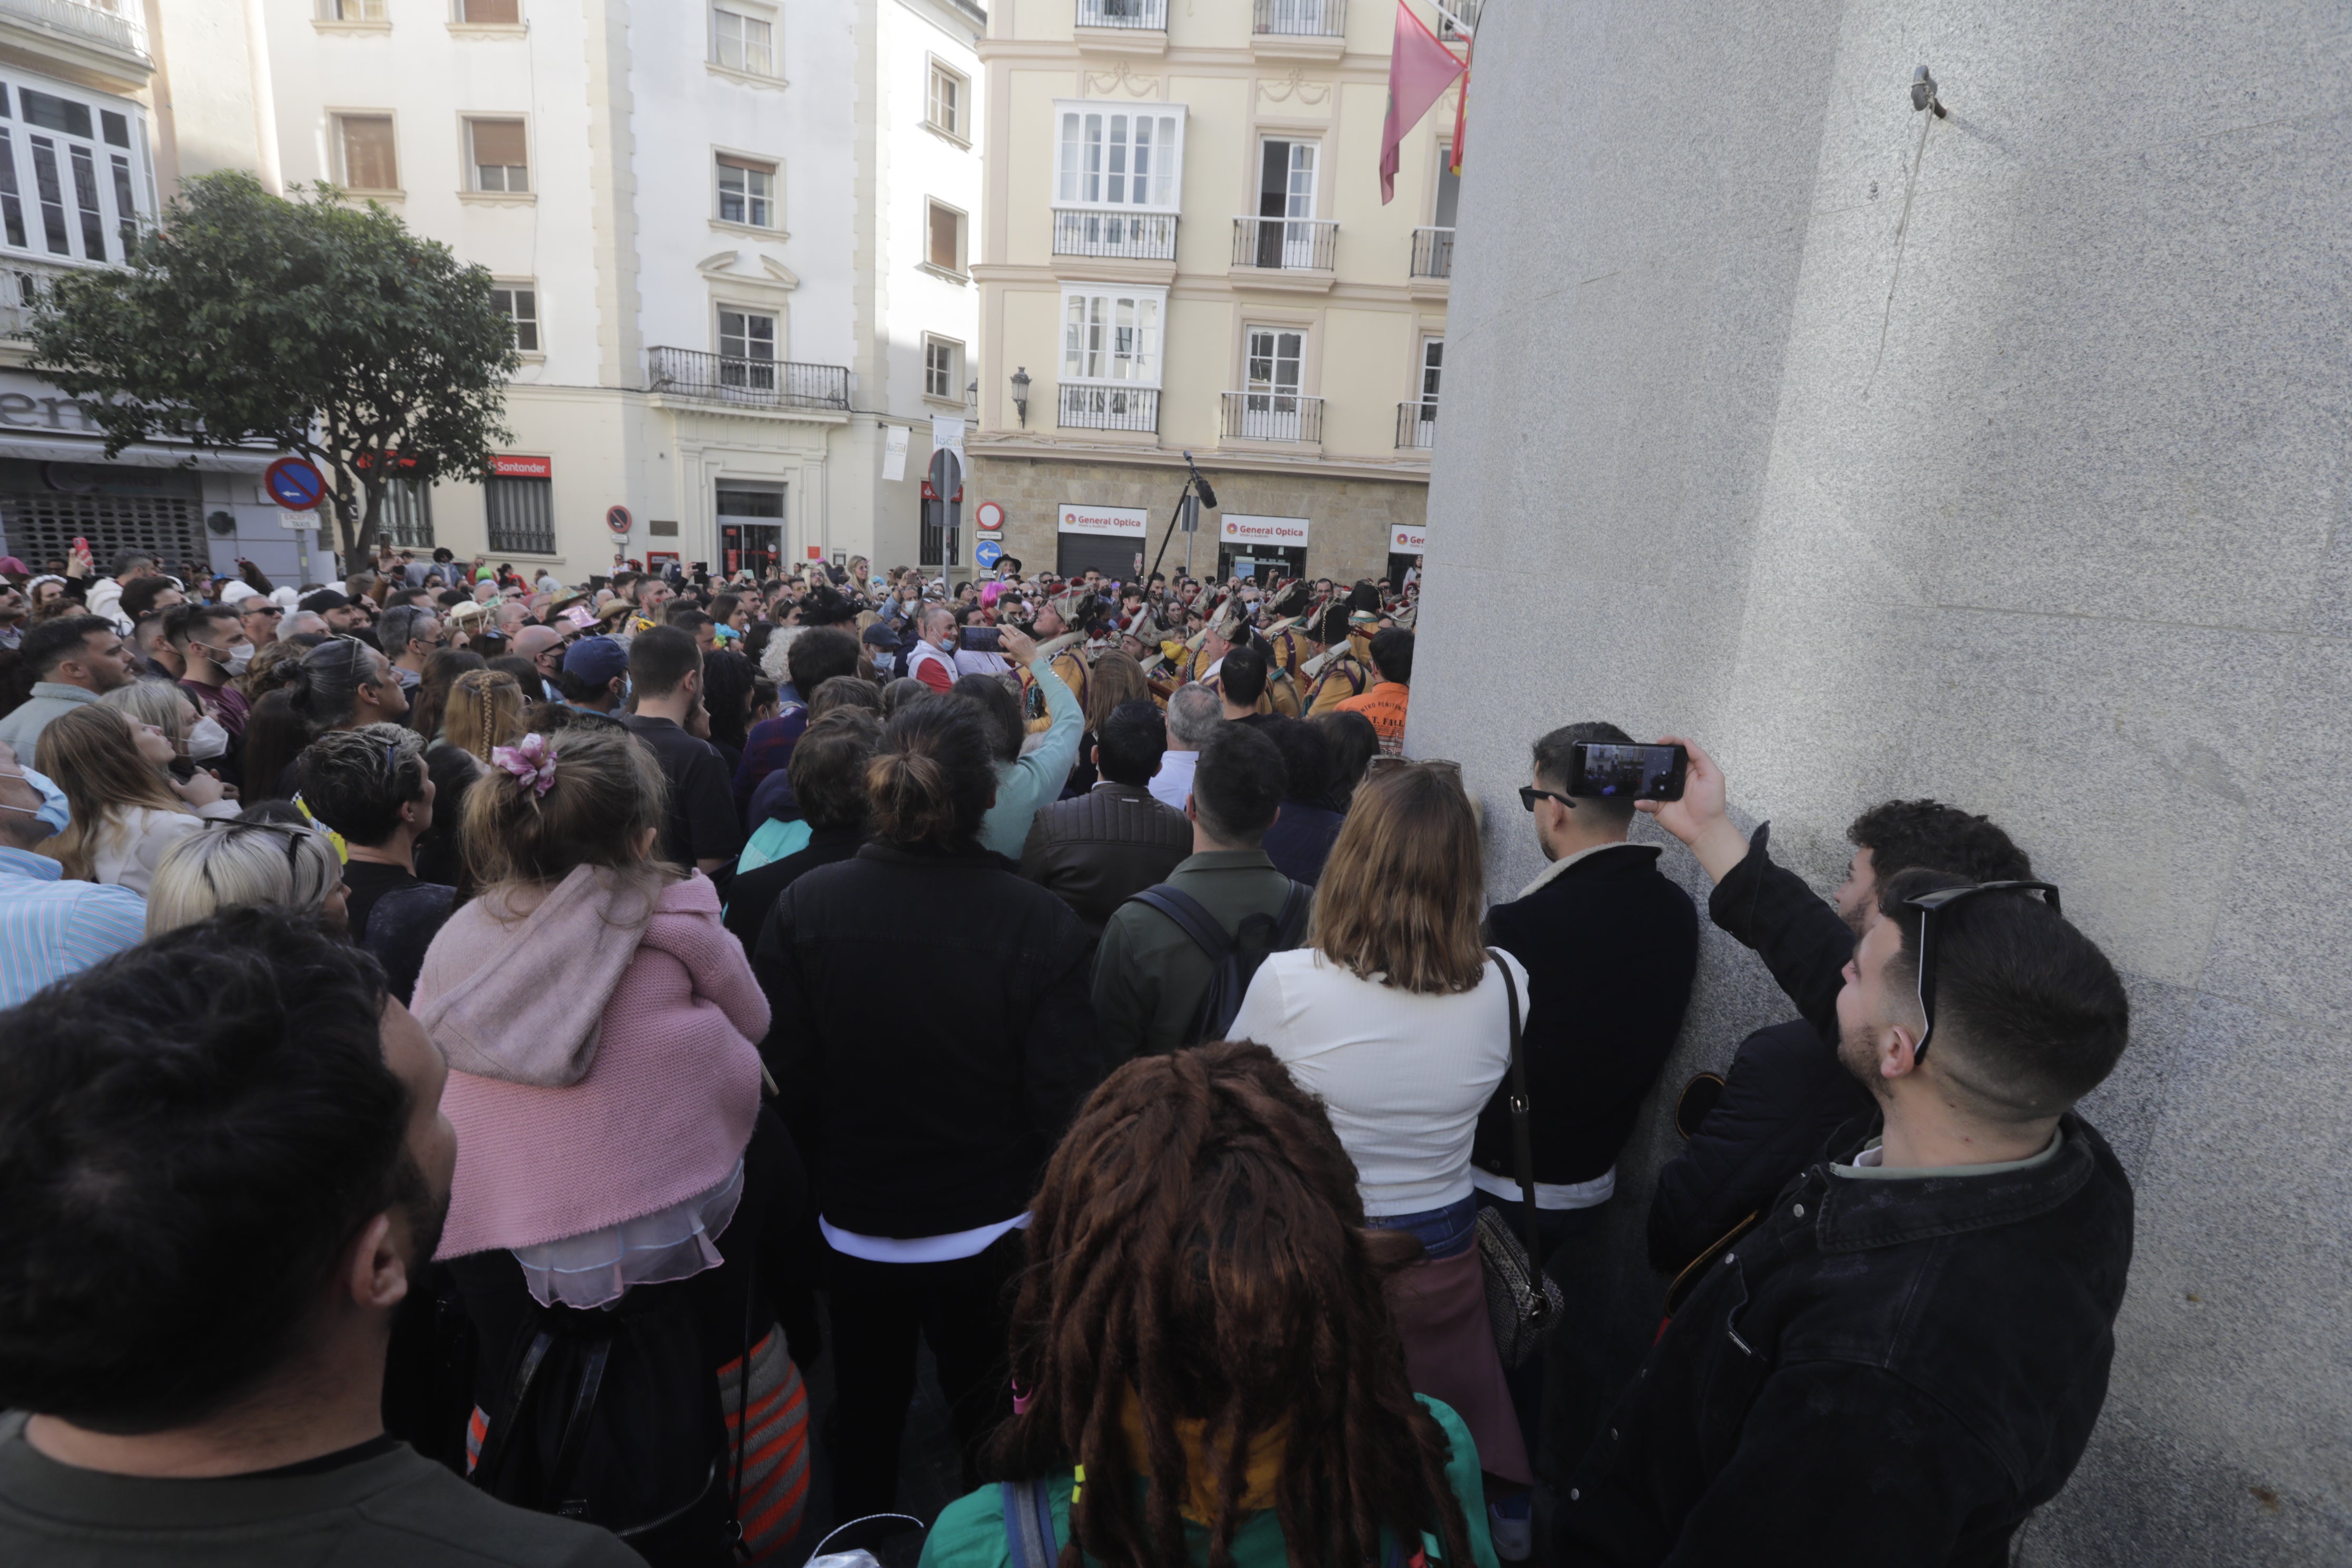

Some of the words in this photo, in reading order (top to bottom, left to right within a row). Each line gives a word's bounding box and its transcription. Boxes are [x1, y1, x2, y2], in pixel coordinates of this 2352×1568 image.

[497, 462, 546, 473] Santander
[1078, 516, 1111, 525] General
[1113, 518, 1141, 527] Optica
[1240, 525, 1273, 534] General
[1276, 527, 1303, 536] Optica
[1360, 702, 1376, 712] NTRO
[1383, 718, 1405, 727] FALL
